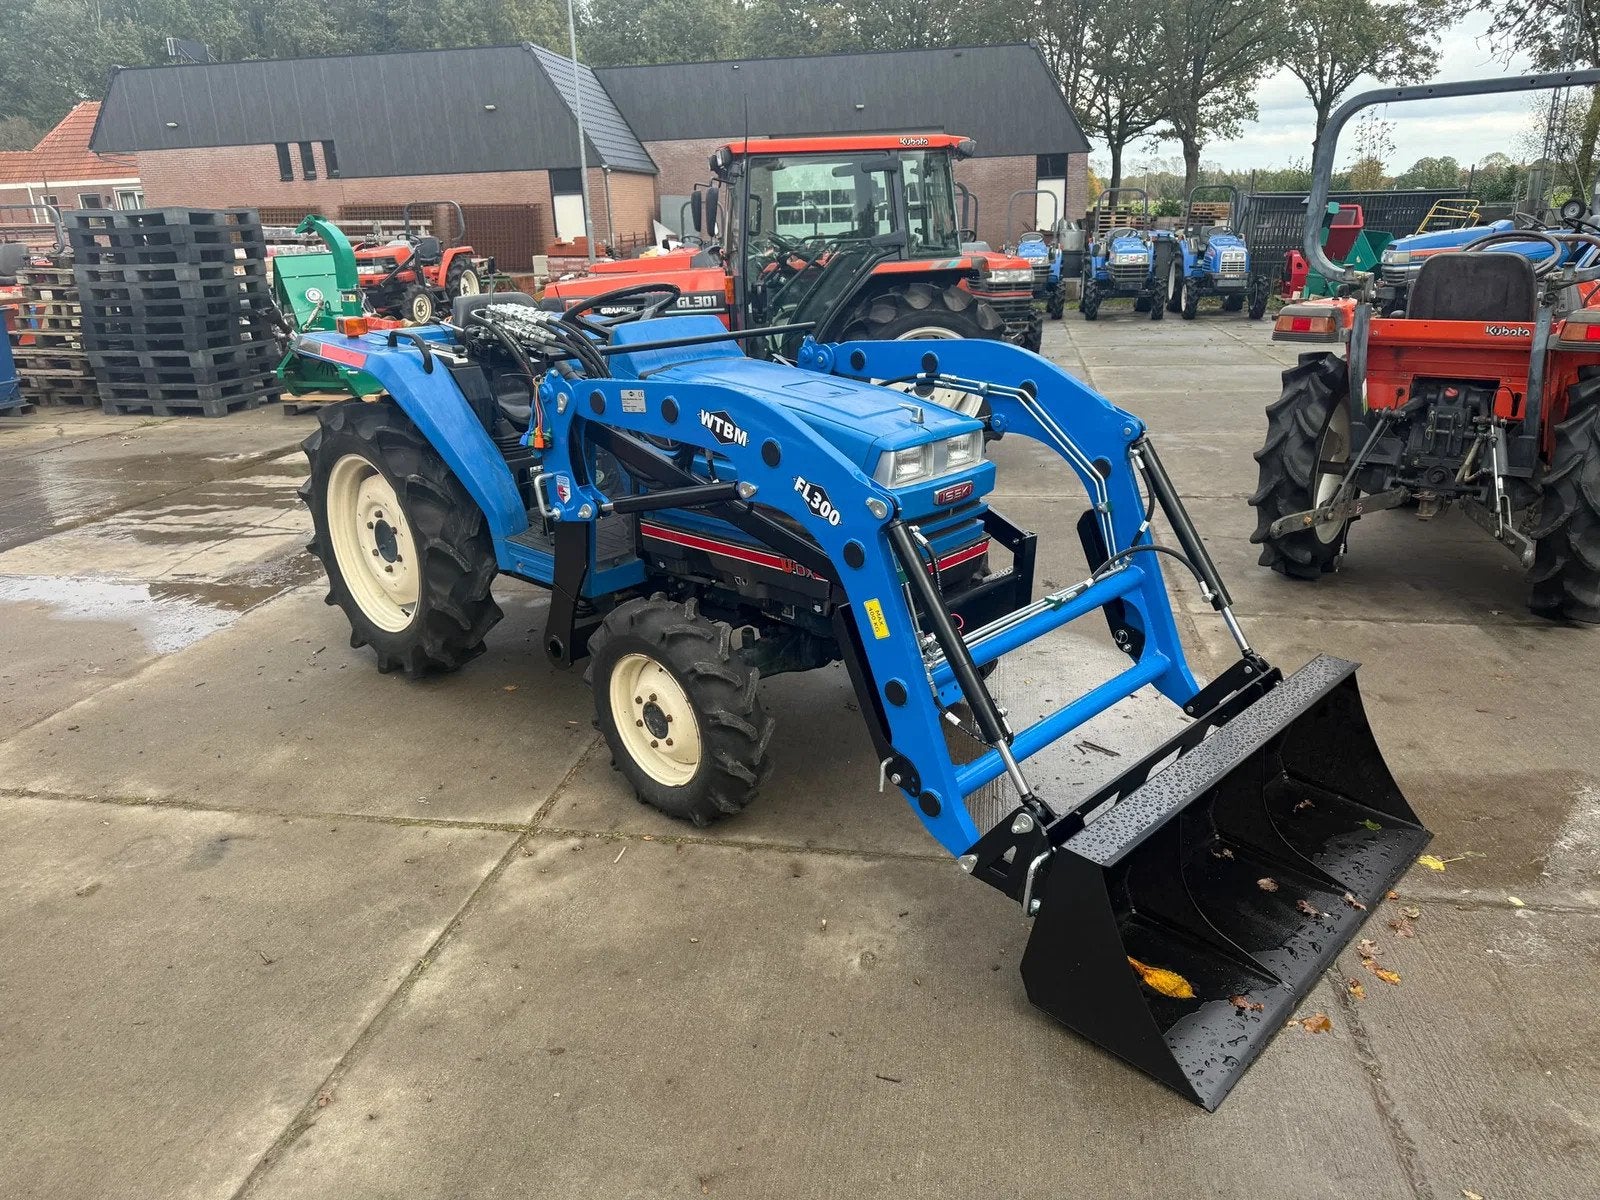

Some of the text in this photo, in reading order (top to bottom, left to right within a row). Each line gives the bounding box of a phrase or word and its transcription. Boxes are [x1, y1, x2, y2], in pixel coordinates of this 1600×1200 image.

[899, 137, 928, 146] Kubota
[676, 295, 717, 309] GL301
[1485, 325, 1531, 337] Kubota
[700, 408, 748, 447] WTBM
[793, 475, 840, 526] FL300
[938, 484, 973, 504] ISEKI
[868, 606, 881, 633] 400 KG
[874, 609, 884, 626] MAX
